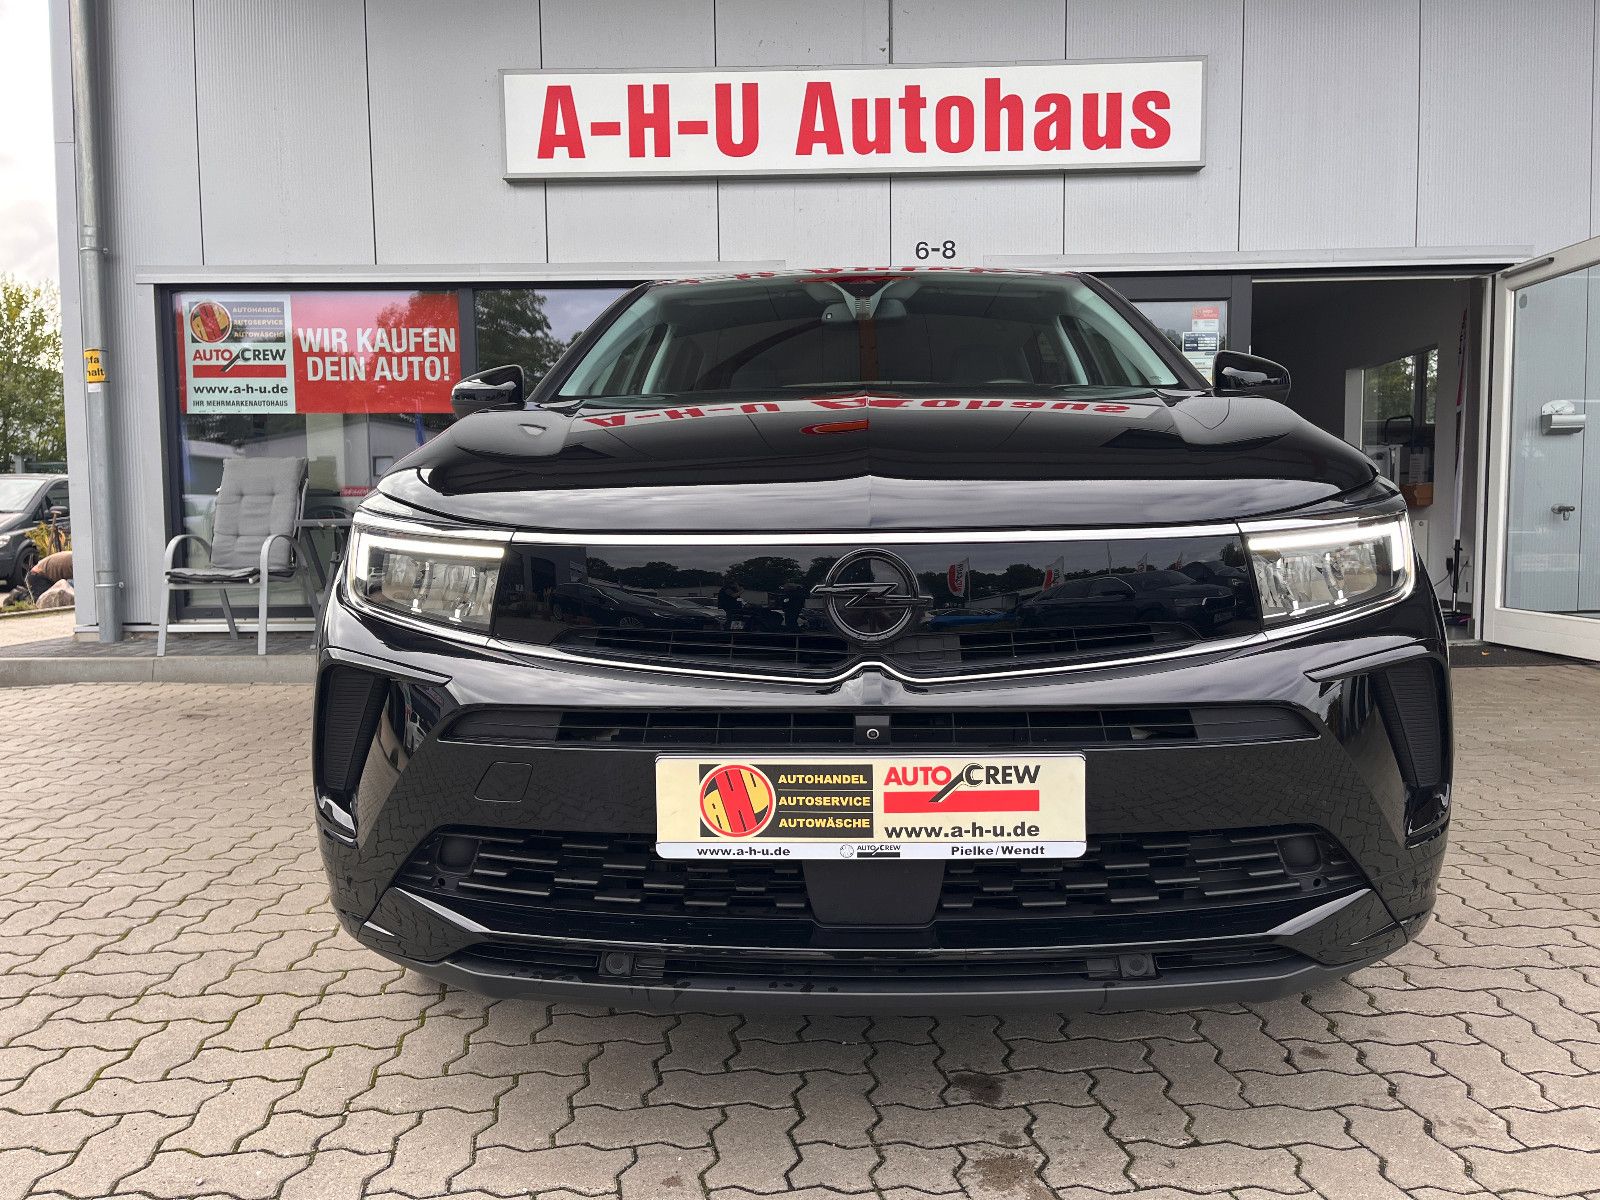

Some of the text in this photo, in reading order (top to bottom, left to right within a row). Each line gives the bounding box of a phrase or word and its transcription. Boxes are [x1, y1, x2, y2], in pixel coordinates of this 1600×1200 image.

[537, 78, 1172, 160] A-H-U Autohaus
[915, 240, 956, 260] 6-8
[297, 327, 456, 353] WIR KAUFEN
[193, 347, 286, 361] AUTO CREW
[306, 356, 450, 382] DEIN AUTO!
[193, 383, 288, 394] www.a-h-u.de
[778, 774, 868, 784] AUTOHANDEL
[884, 763, 1041, 787] AUTO CREW
[778, 796, 871, 806] AUTOSERVICE
[778, 817, 871, 828] AUTOWÄSCHE
[884, 821, 1040, 838] www.a-h-u.de
[697, 846, 791, 856] www.a-h-u.de
